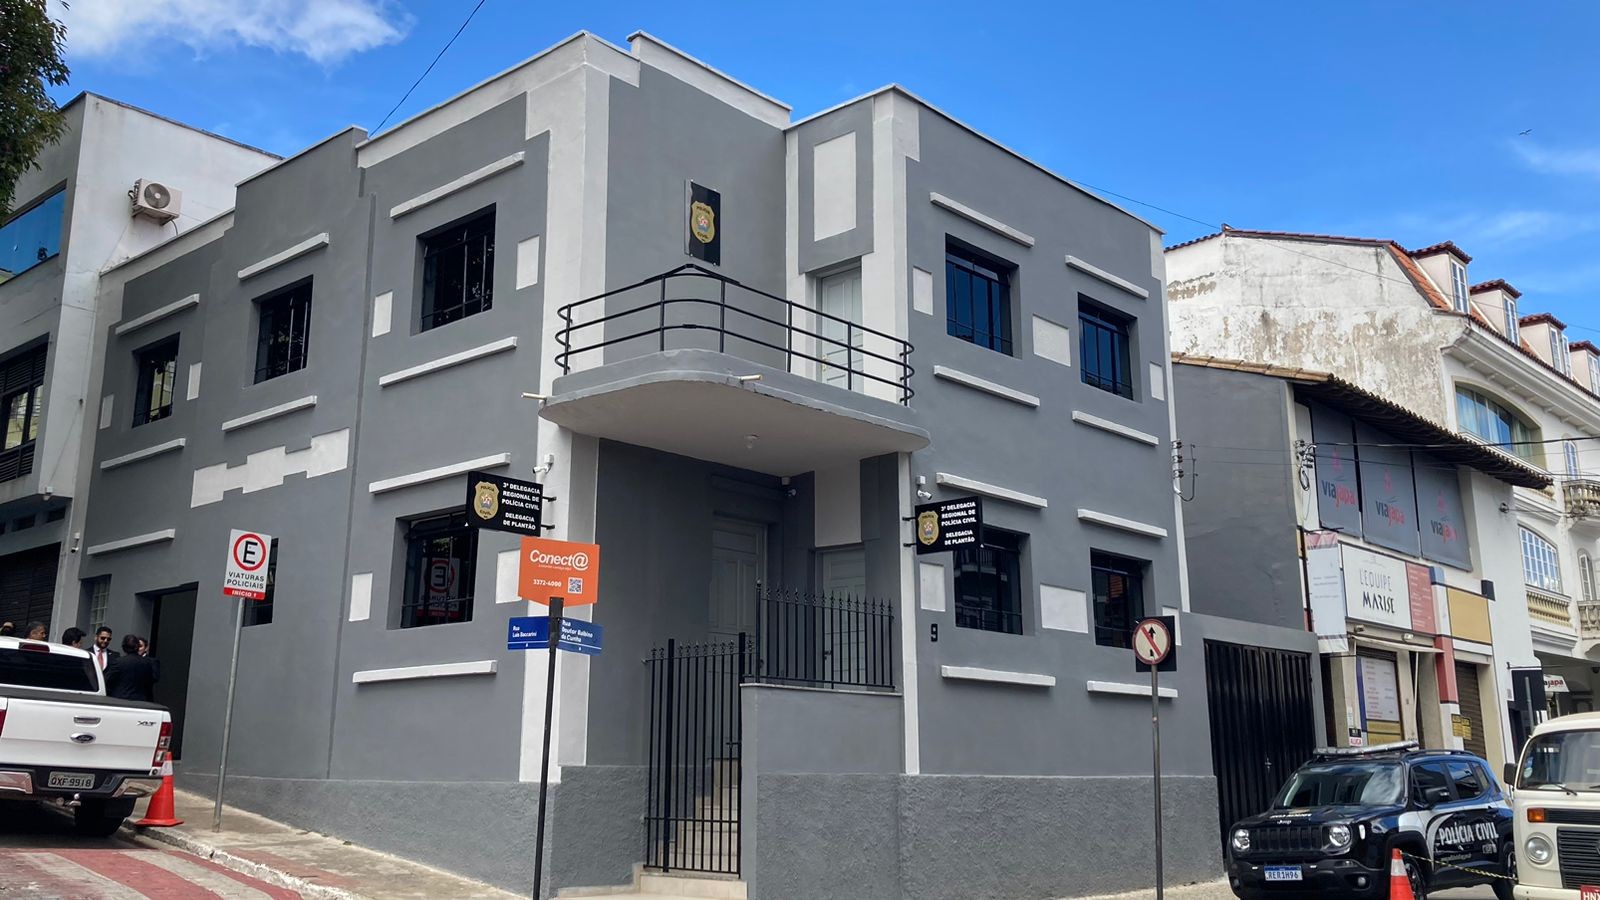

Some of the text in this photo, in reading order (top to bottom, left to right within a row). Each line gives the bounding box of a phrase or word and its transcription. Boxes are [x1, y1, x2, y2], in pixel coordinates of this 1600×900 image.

[510, 484, 540, 494] DELEGACIA
[502, 491, 531, 501] REGIONAL
[501, 498, 540, 510] POLÍCIA CIVIL
[947, 502, 976, 511] DELEGACIA
[505, 512, 535, 522] DELEGACIA
[511, 521, 536, 530] PLANTÃO
[945, 530, 973, 538] DELEGACIA
[243, 540, 258, 564] E
[529, 549, 589, 571] Conect@
[228, 571, 264, 582] VIATURAS
[227, 579, 264, 589] POLICIAIS
[1362, 591, 1395, 614] MARISE
[562, 626, 577, 634] Doutor
[931, 623, 938, 642] 9
[567, 634, 582, 642] Cunha
[1438, 821, 1499, 846] POLÍCIA CIVIL
